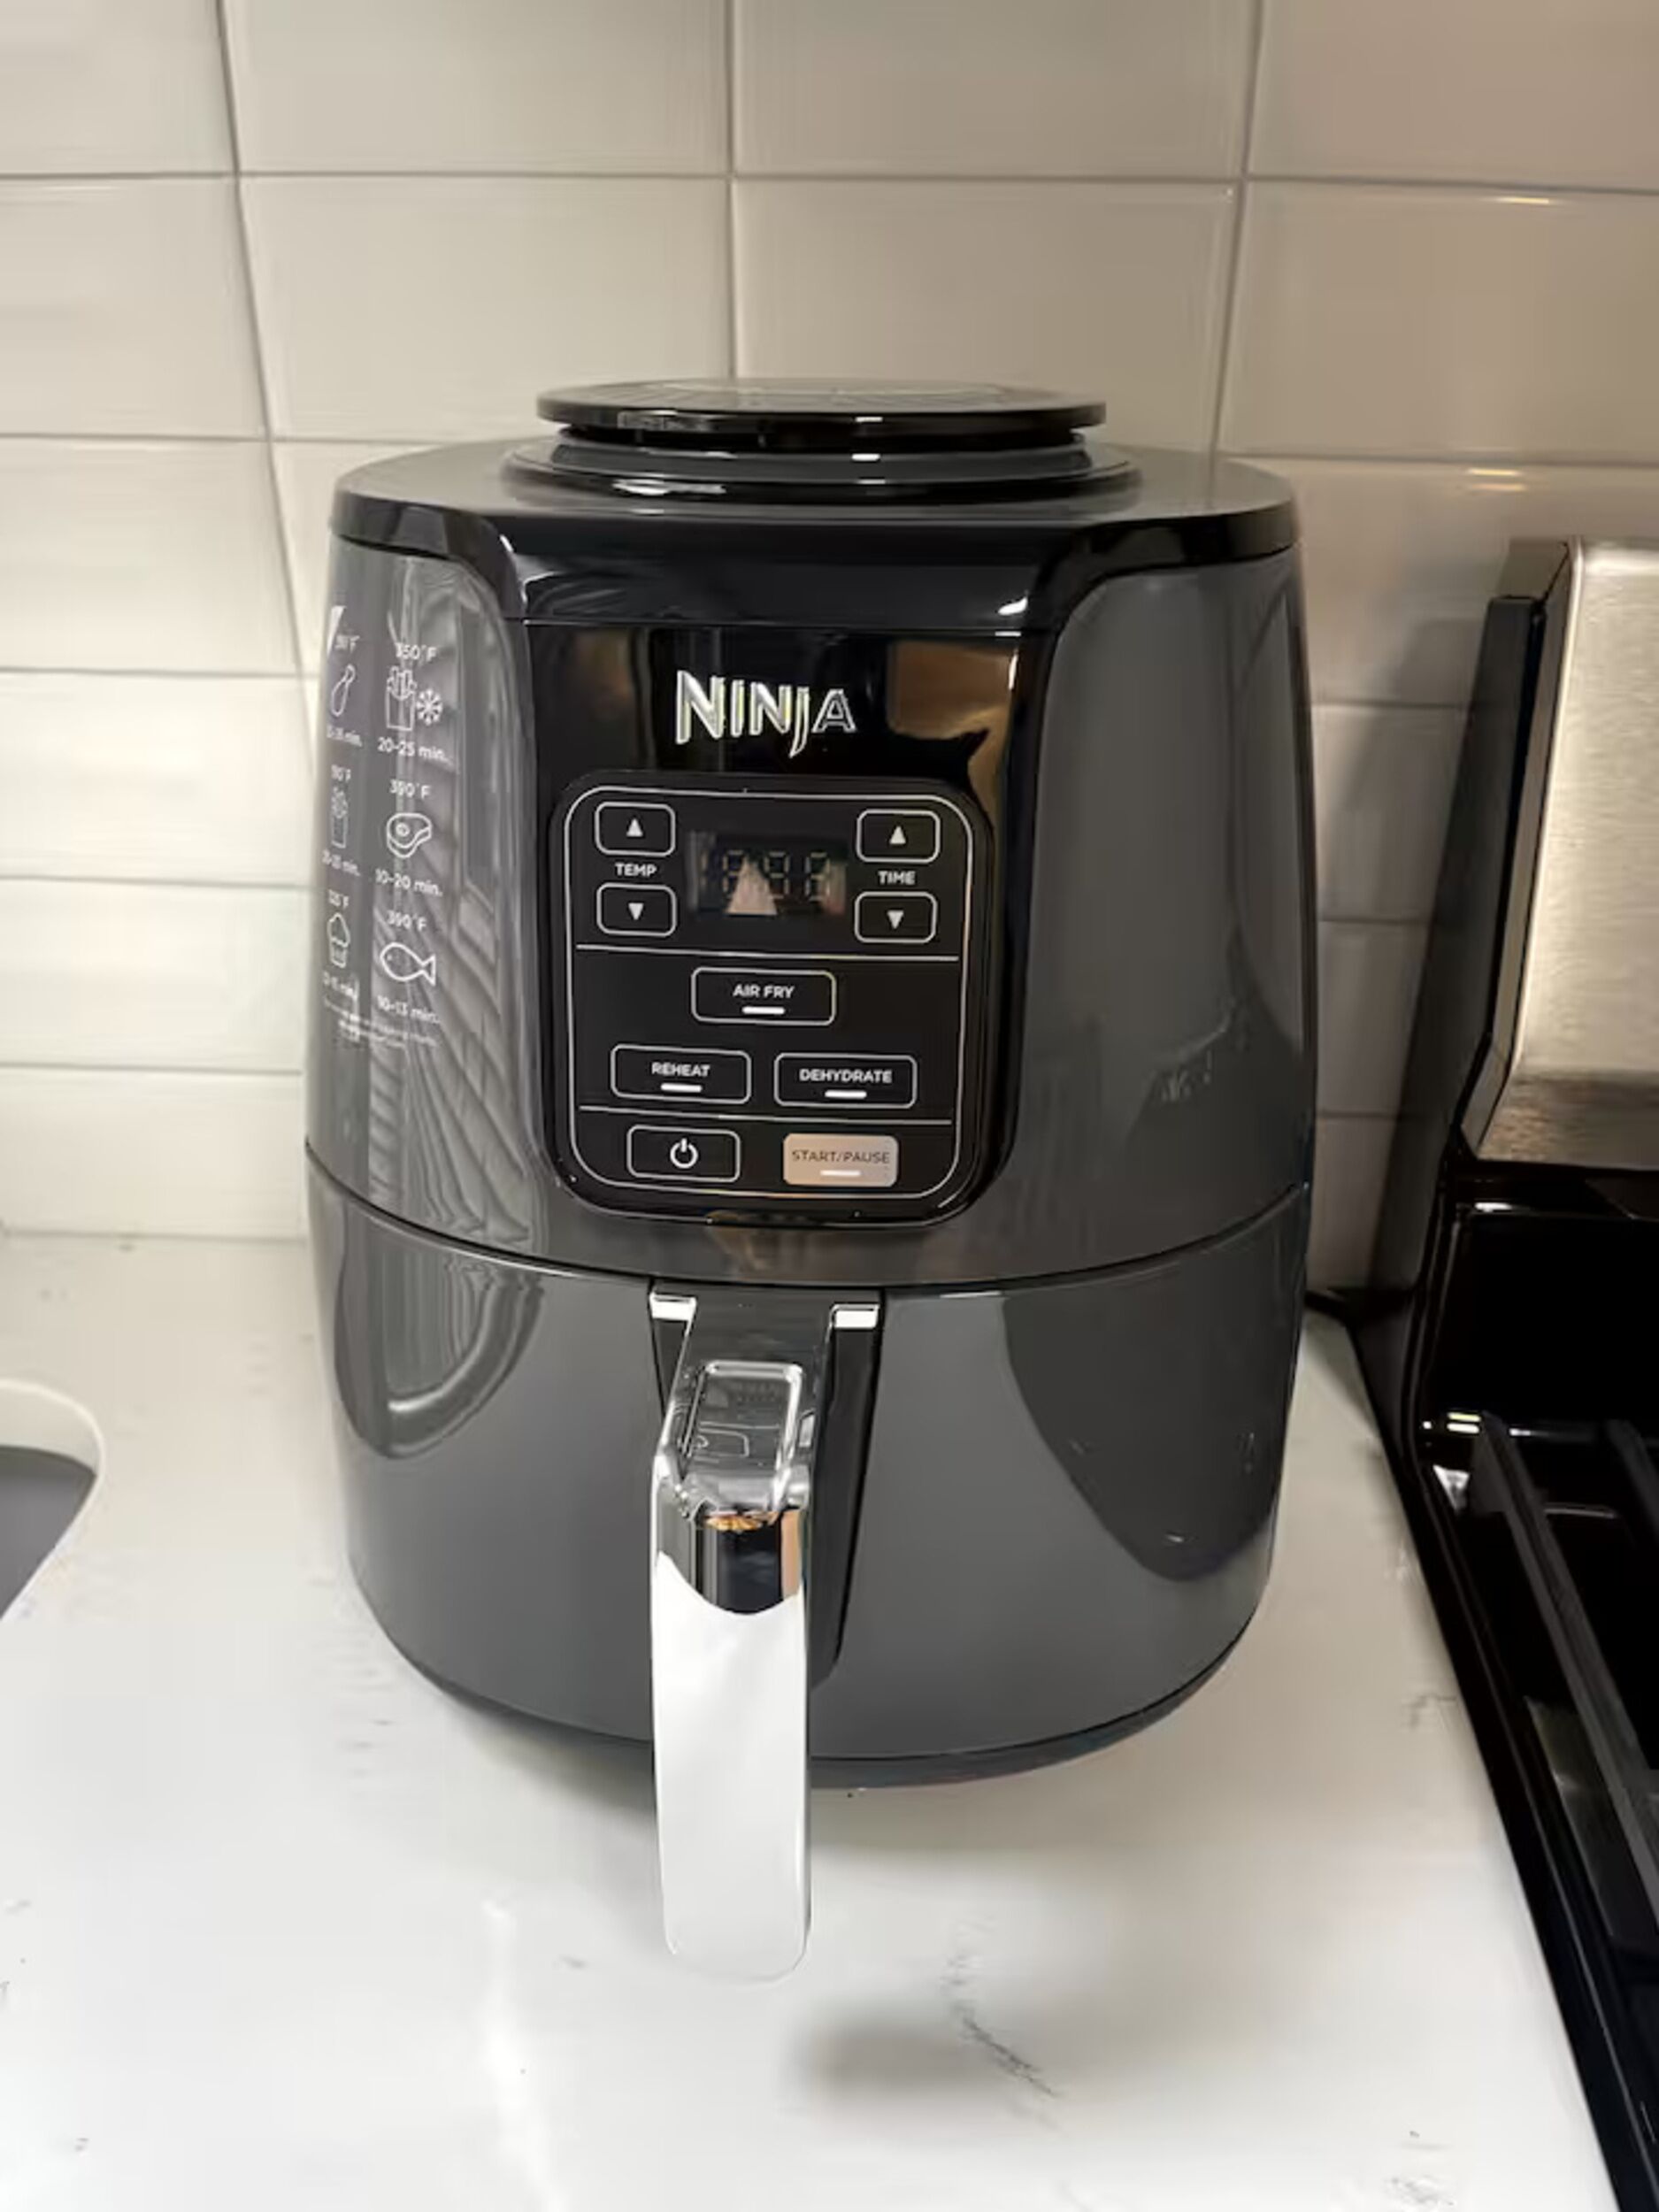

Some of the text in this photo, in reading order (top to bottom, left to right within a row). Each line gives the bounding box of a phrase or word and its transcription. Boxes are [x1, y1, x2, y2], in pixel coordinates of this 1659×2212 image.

[675, 670, 856, 758] NINJA
[378, 736, 416, 757] 20-25
[615, 863, 657, 878] TEMP
[878, 870, 916, 886] TIME
[732, 983, 795, 999] AIR FRY
[650, 1062, 710, 1078] REHEAT
[799, 1068, 893, 1085] DEHYDRATE
[791, 1149, 891, 1165] START/PAUSE
